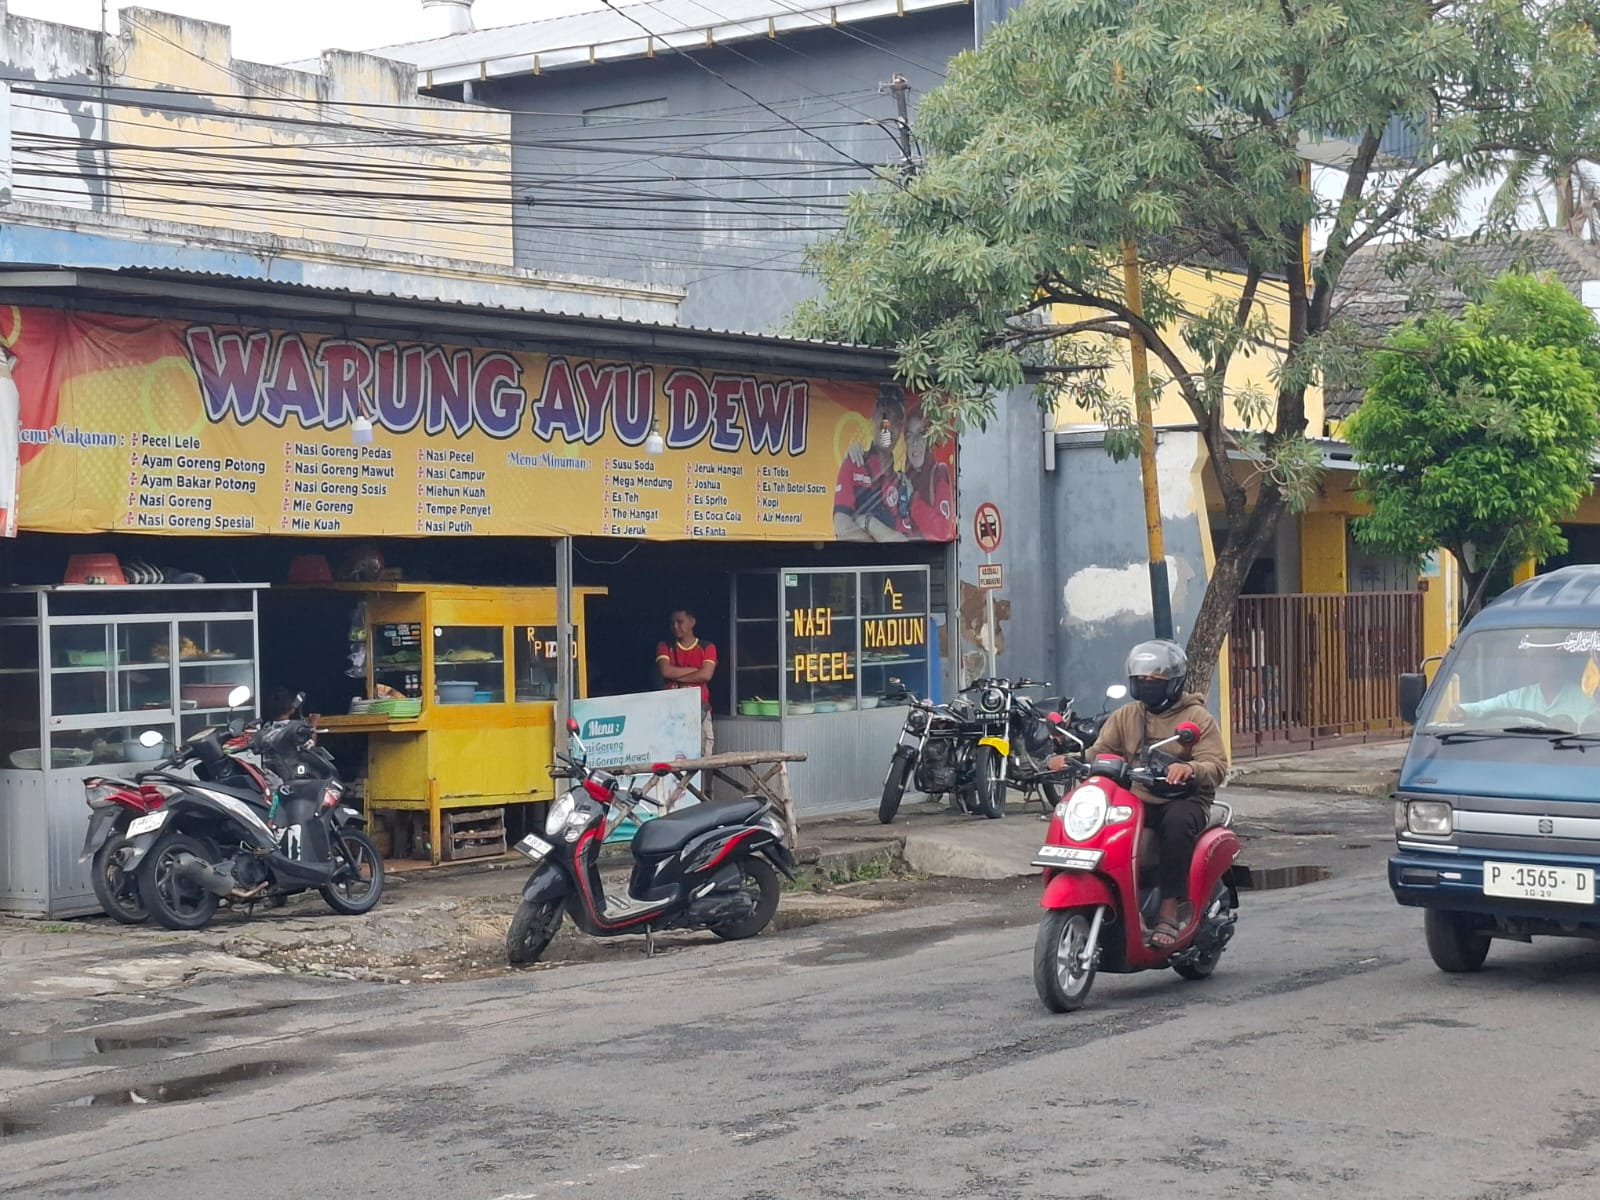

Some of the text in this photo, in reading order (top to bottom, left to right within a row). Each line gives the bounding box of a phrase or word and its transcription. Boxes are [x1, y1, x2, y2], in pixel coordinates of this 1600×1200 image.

[185, 325, 809, 457] WARUNG AYU DEWI
[18, 428, 48, 442] enu
[51, 425, 117, 448] Makanan
[142, 434, 200, 449] Pecel Lele
[295, 444, 391, 459] Nasi Goreng Pedas
[426, 450, 474, 463] Nasi Pecel
[142, 454, 265, 474] Ayam Goreng Potong
[508, 452, 537, 465] Menu
[540, 452, 586, 468] Minuman
[612, 459, 654, 471] Susu Soda
[295, 463, 394, 478] Nasi Goreng Mawut
[426, 468, 485, 480] Nasi Campur
[694, 464, 742, 476] Jeruk Hangat
[763, 467, 770, 476] Es
[140, 474, 256, 492] Ayam Bakar Potong
[295, 482, 387, 496] Nasi Goreng Sosis
[612, 476, 672, 489] Mega Mendung
[694, 479, 720, 489] Joshua
[763, 482, 770, 491] Es
[463, 487, 485, 498] Kuah
[612, 492, 638, 502] Es Teh
[140, 494, 212, 509] Nasi Goreng
[694, 495, 703, 504] Es
[293, 500, 353, 514] Mie Goreng
[426, 504, 491, 517] Tempe Penyet
[630, 509, 658, 520] Hangat
[694, 511, 703, 520] Es
[706, 511, 723, 520] Coca
[138, 514, 254, 529] Nasi Goreng Spesial
[292, 519, 340, 530] Mie Kuah
[425, 522, 472, 532] Nasi Putih
[612, 525, 646, 534] Es Jeruk
[694, 527, 726, 536] Es Fanta
[794, 607, 831, 637] NASI
[865, 617, 924, 648] MADIUN
[794, 652, 854, 684] PECEL
[589, 720, 614, 736] Menu
[596, 742, 623, 751] Goreng
[596, 757, 623, 765] Goreng
[1492, 867, 1586, 890] P 1565 D
